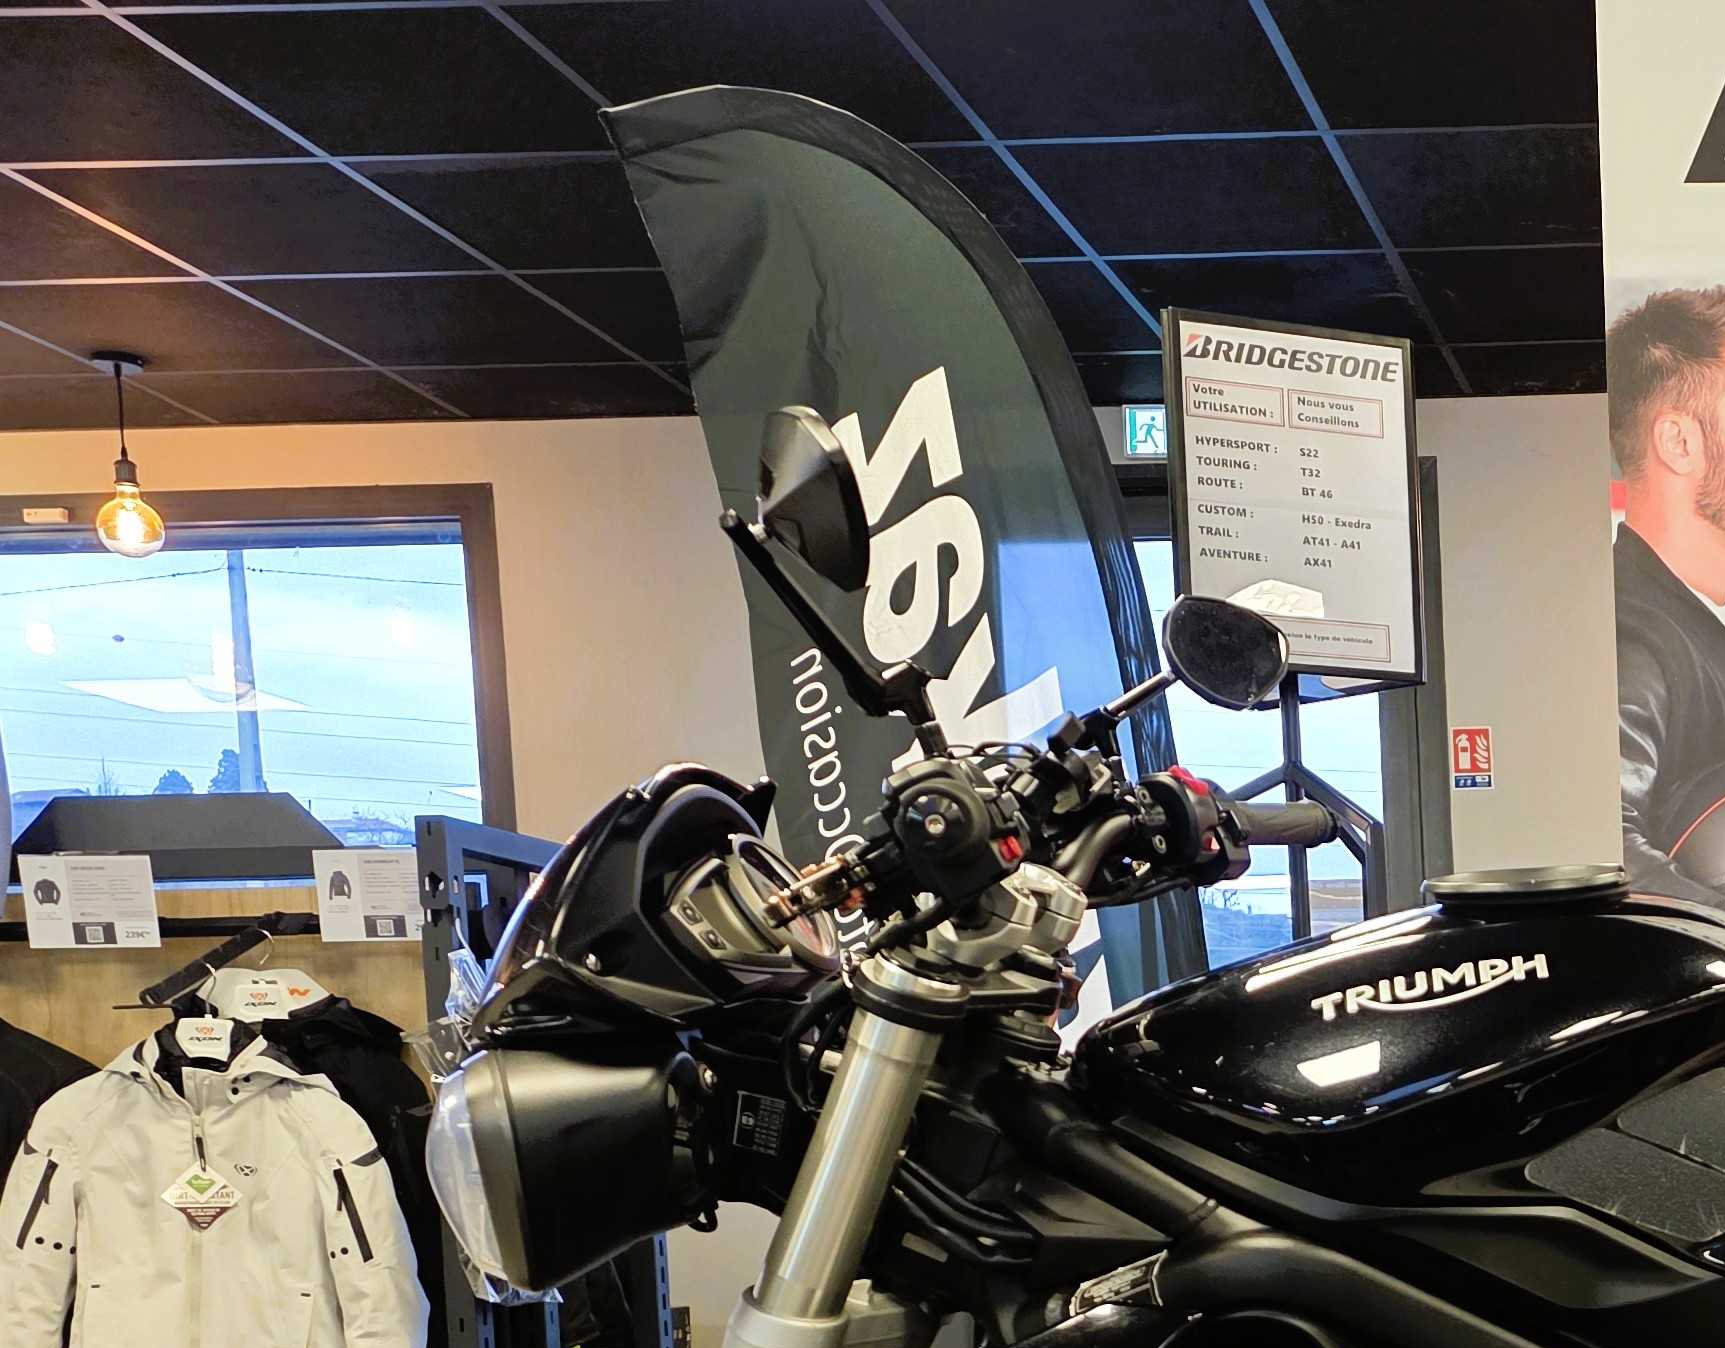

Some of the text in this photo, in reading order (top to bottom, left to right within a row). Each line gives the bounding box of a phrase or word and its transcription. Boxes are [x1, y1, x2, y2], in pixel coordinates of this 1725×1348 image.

[1183, 334, 1399, 383] BRIDGESTONE
[1192, 383, 1225, 397] Votre
[1193, 400, 1268, 418] UTILISATION
[1297, 396, 1355, 412] Nous vous
[1297, 412, 1360, 429] Conseillons
[1195, 435, 1271, 453] HYPERSPORT
[1299, 447, 1320, 459] S22
[1196, 456, 1251, 470] TOURING
[1300, 467, 1321, 479] T32
[1197, 476, 1237, 490] ROUTE
[1302, 487, 1334, 499] BT 46
[1197, 503, 1248, 519] CUSTOM
[1334, 518, 1372, 531] Exedra
[1198, 525, 1233, 539] TRAIL
[1302, 535, 1331, 548] AT41
[1340, 539, 1362, 551] A41
[1199, 547, 1262, 562] AVENTURE
[1303, 557, 1333, 569] AX41
[1310, 953, 1550, 1022] TRIUMPH
